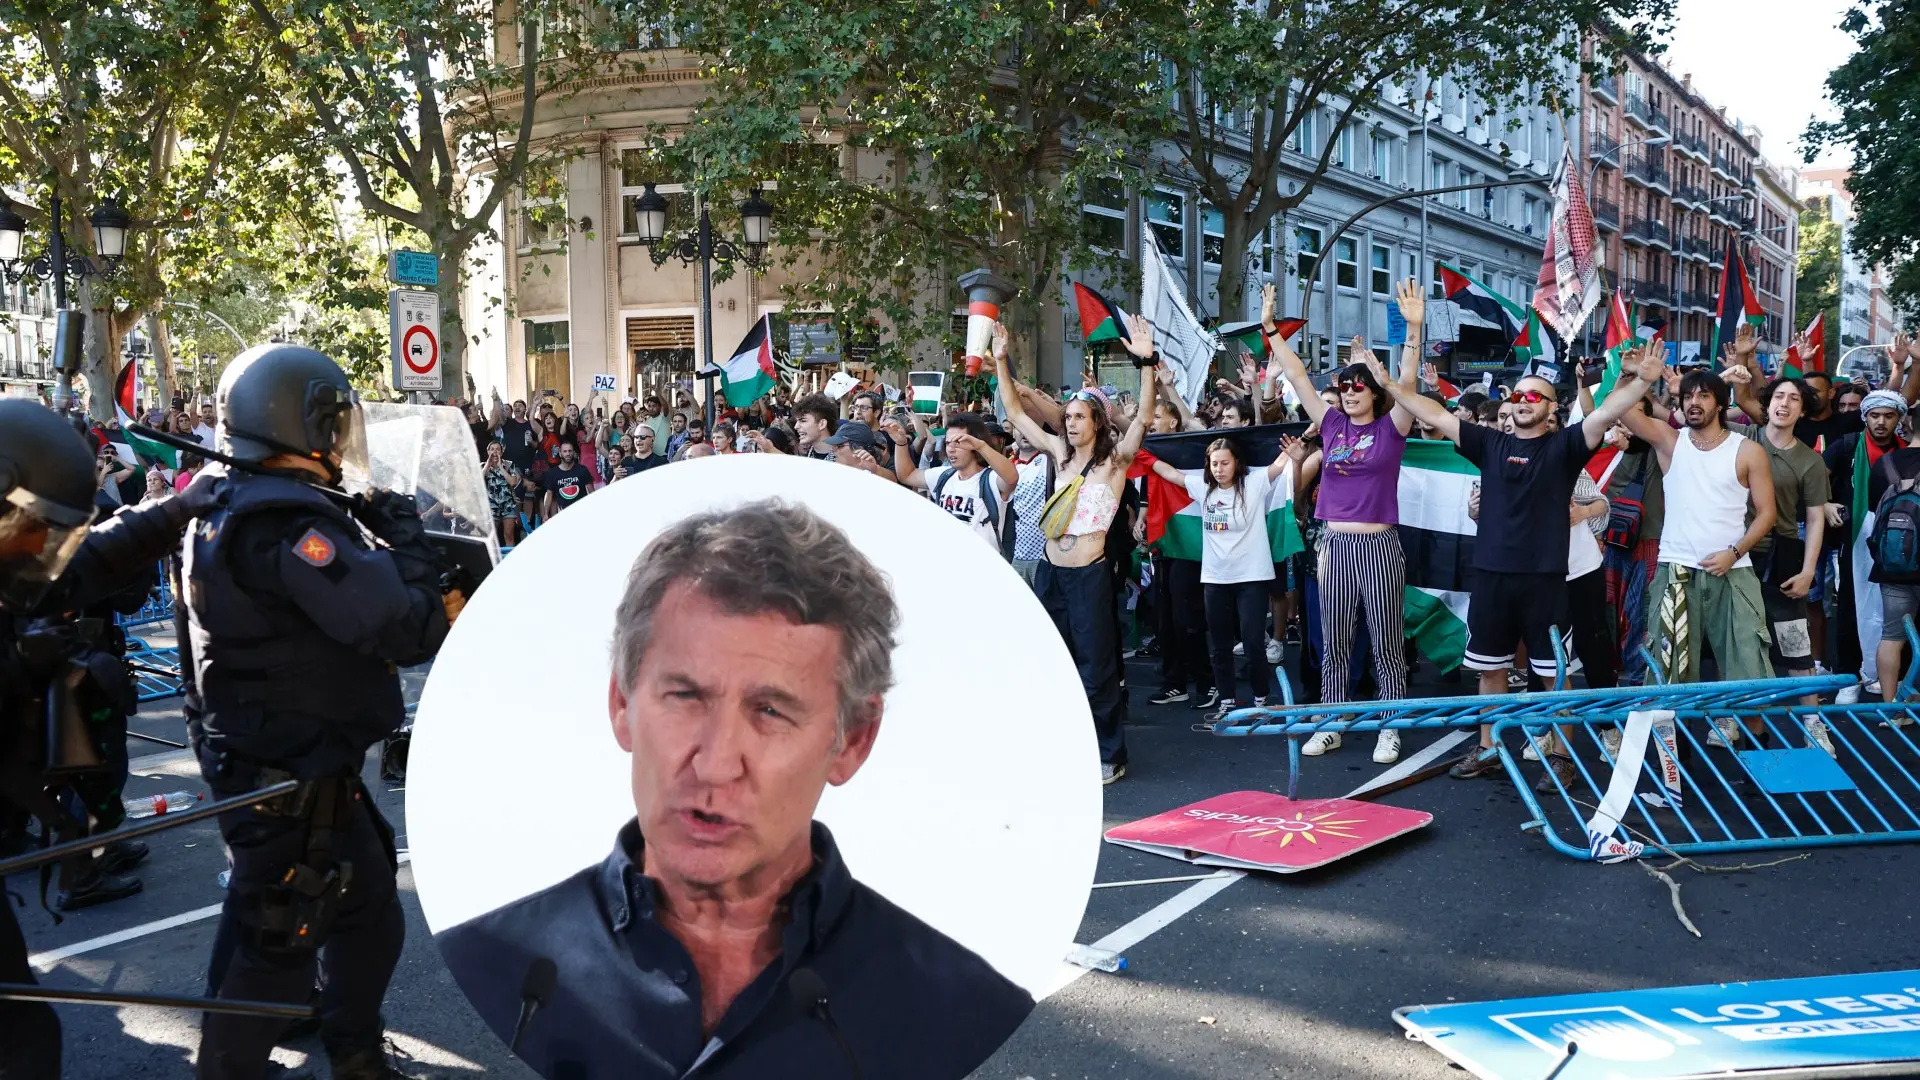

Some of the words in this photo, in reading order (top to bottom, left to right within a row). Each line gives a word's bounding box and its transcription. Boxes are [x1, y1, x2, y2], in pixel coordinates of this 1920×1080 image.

[595, 376, 615, 389] PAZ
[1184, 808, 1314, 832] Cofidis
[1755, 1023, 1840, 1034] CON
[1846, 1019, 1899, 1031] EL
